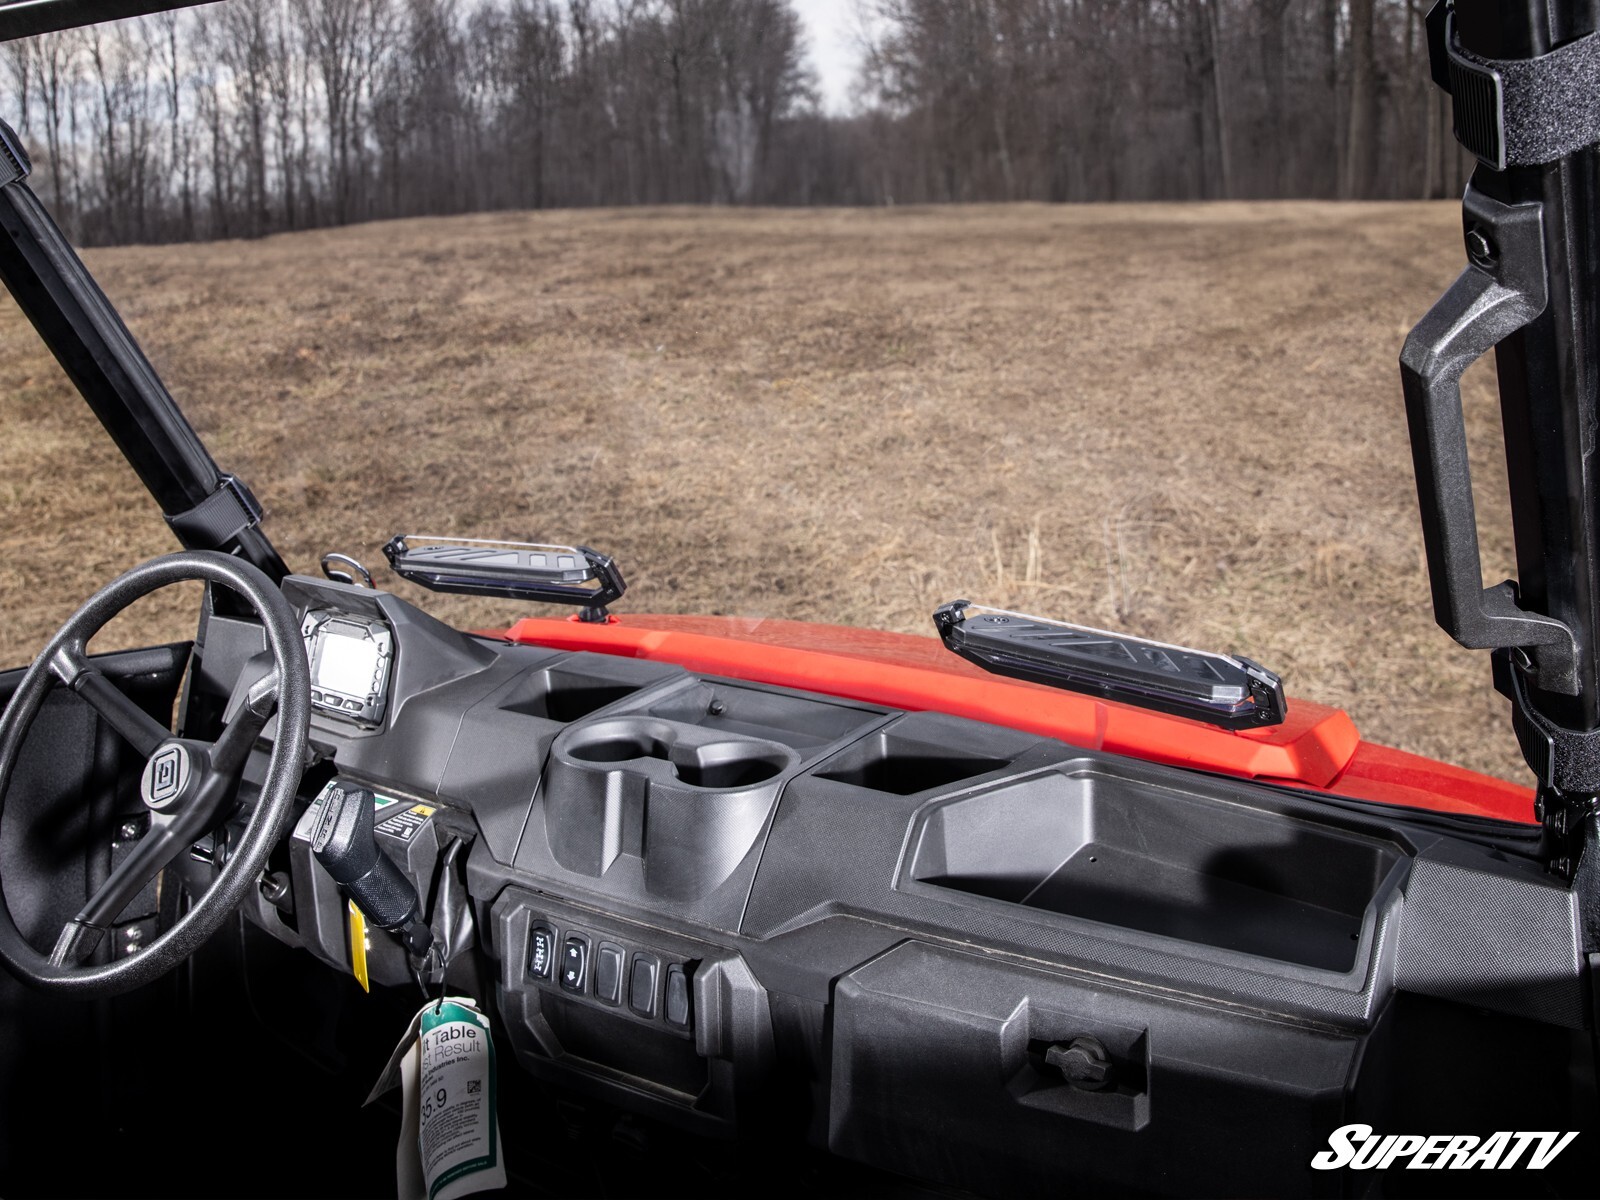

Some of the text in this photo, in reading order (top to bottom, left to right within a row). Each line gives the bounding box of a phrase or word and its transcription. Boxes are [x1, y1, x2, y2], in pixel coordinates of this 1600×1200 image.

[432, 1025, 477, 1046] Table
[434, 1040, 481, 1062] Result
[428, 1058, 456, 1075] Industries
